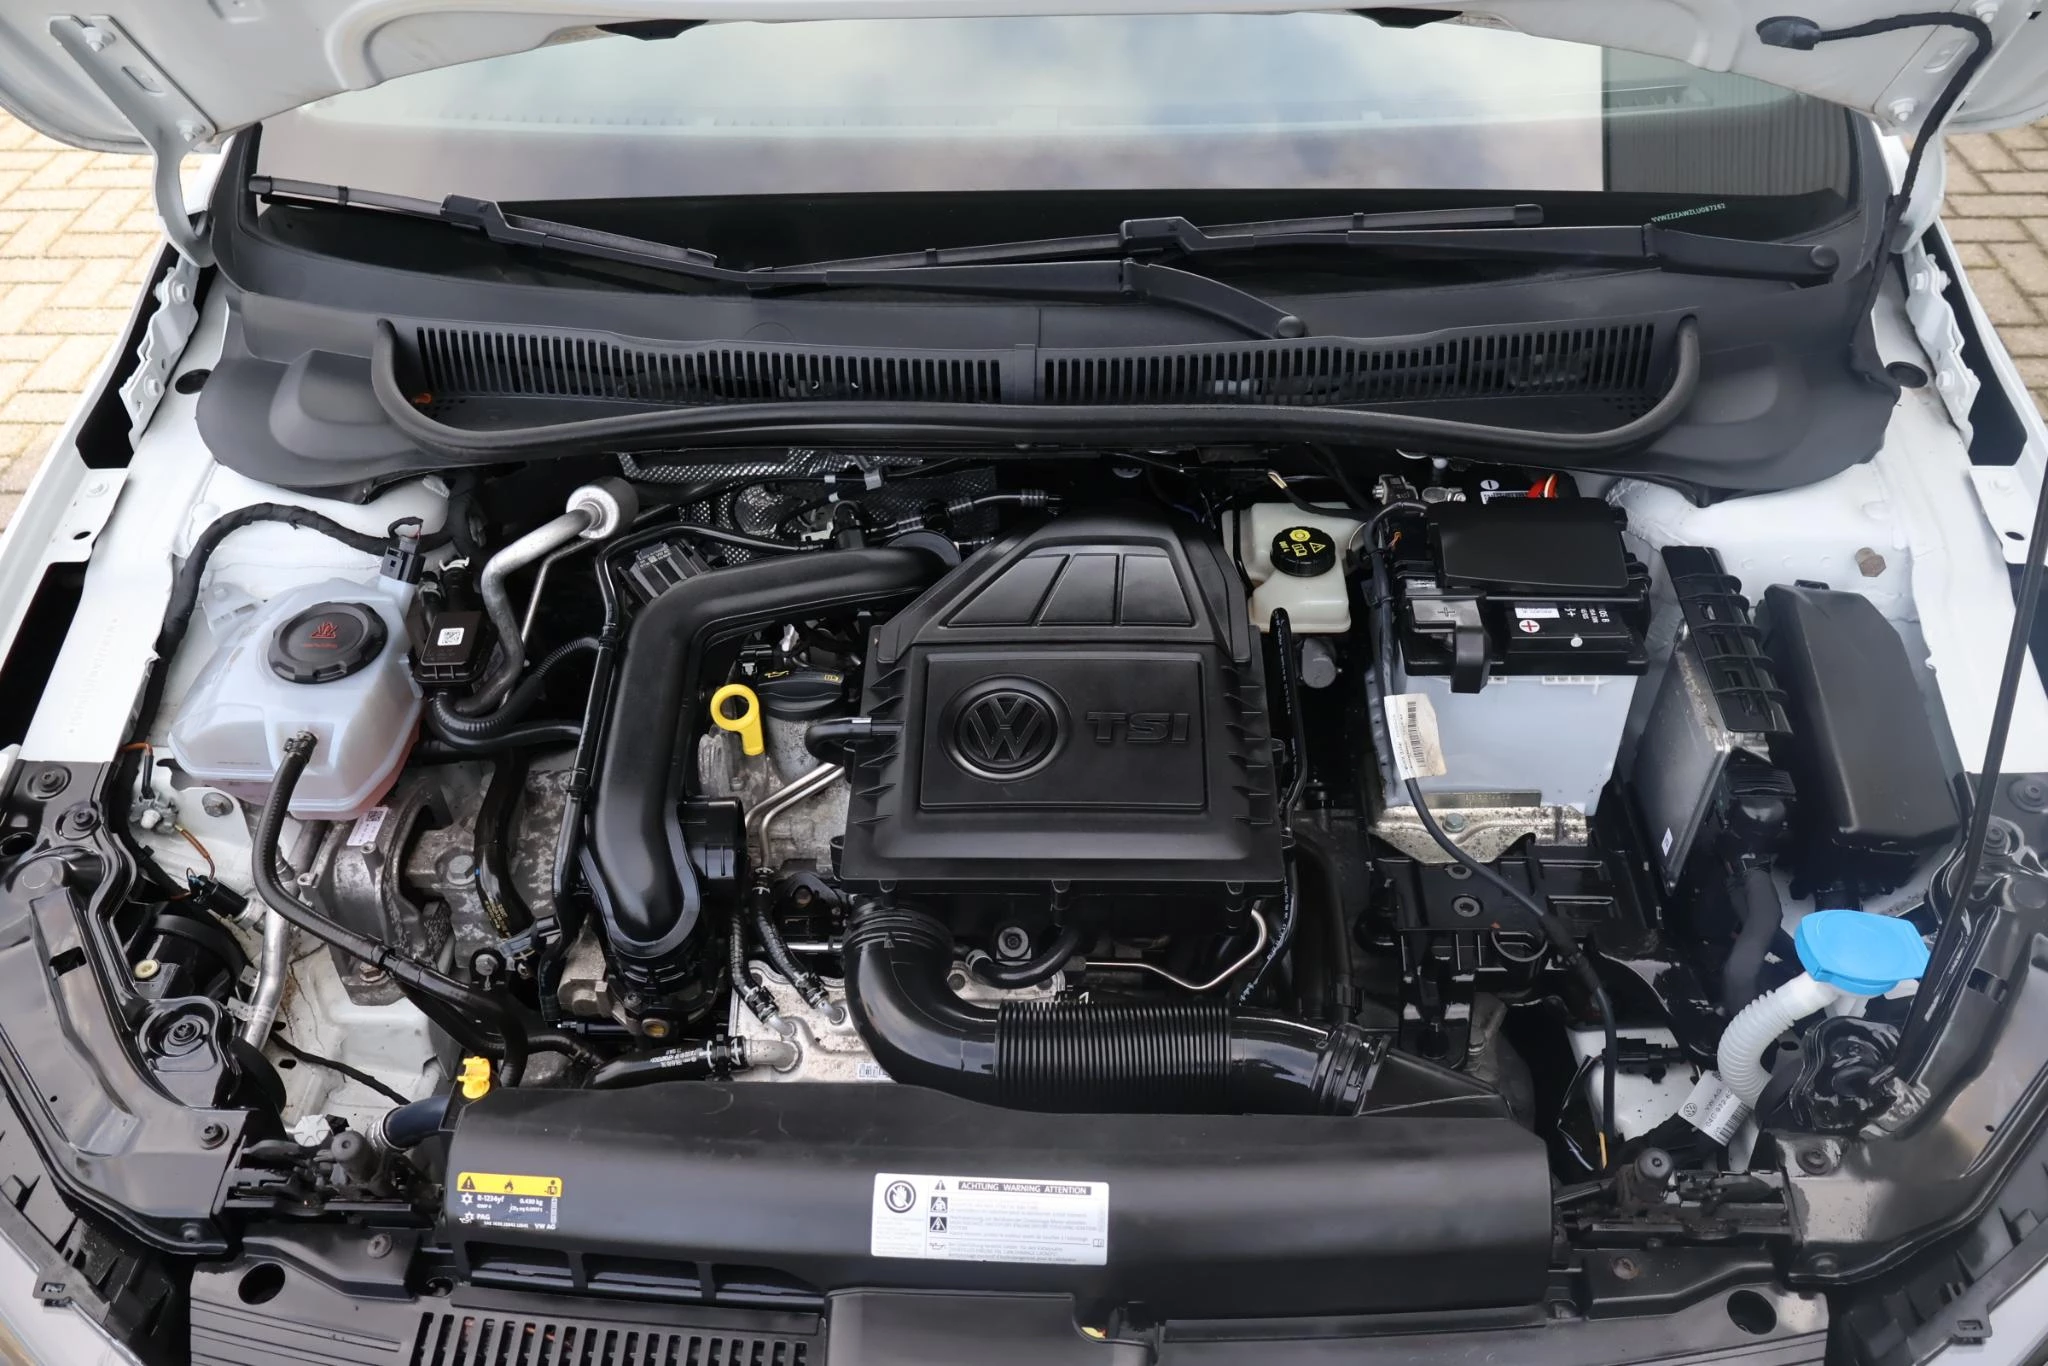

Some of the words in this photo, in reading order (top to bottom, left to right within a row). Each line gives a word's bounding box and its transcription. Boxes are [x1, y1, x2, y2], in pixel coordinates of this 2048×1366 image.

[1086, 711, 1190, 743] TSI
[961, 1182, 999, 1191] ACHTUNG
[1003, 1183, 1041, 1193] WARNING
[1044, 1185, 1087, 1195] ATTENTION
